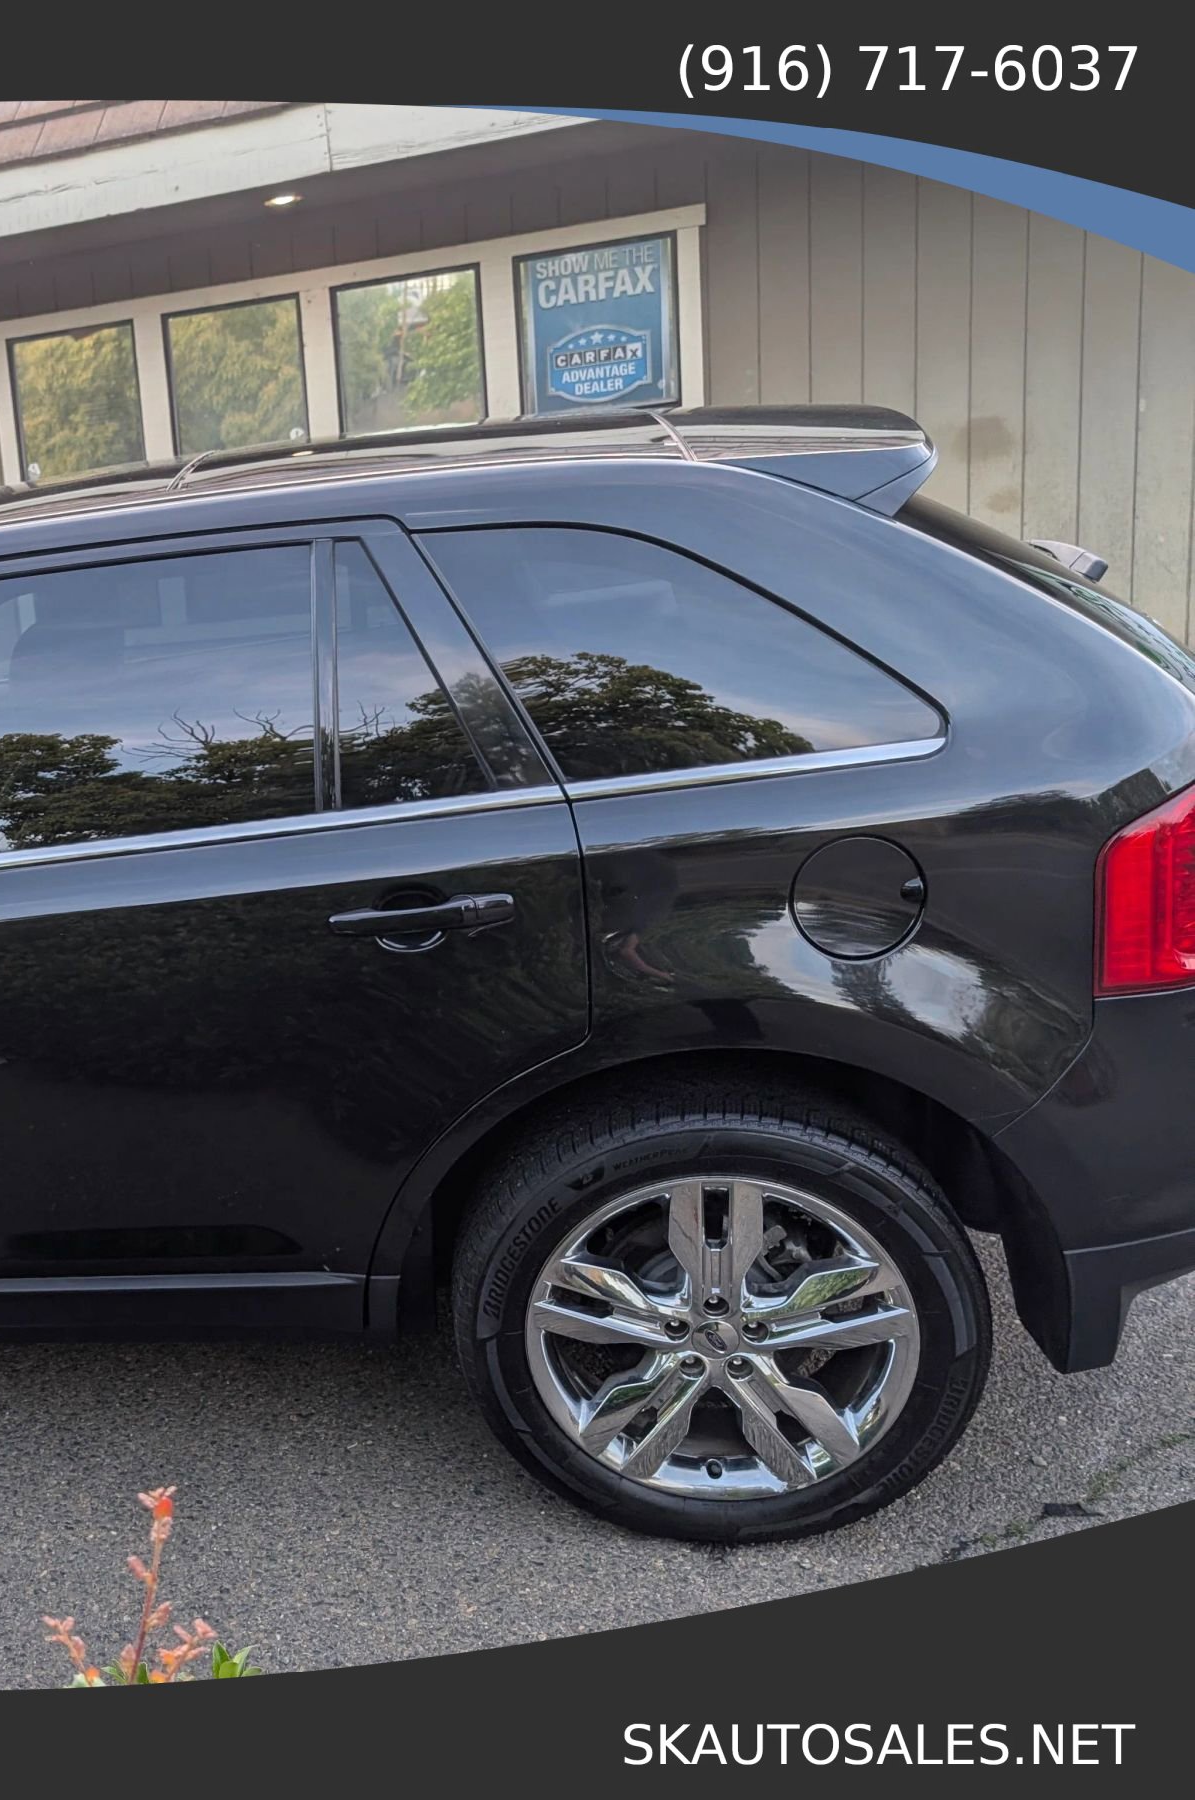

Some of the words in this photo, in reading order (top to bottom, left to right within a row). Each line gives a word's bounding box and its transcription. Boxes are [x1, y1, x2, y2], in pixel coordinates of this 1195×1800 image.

[536, 253, 589, 279] SHOW
[594, 249, 619, 271] ME
[622, 243, 655, 266] THE
[538, 264, 656, 309] CARFAX
[556, 345, 640, 367] CARFAX
[561, 361, 636, 384] ADVANTAGE
[574, 377, 624, 395] DEALER
[482, 1200, 563, 1321] BRIDGESTONE
